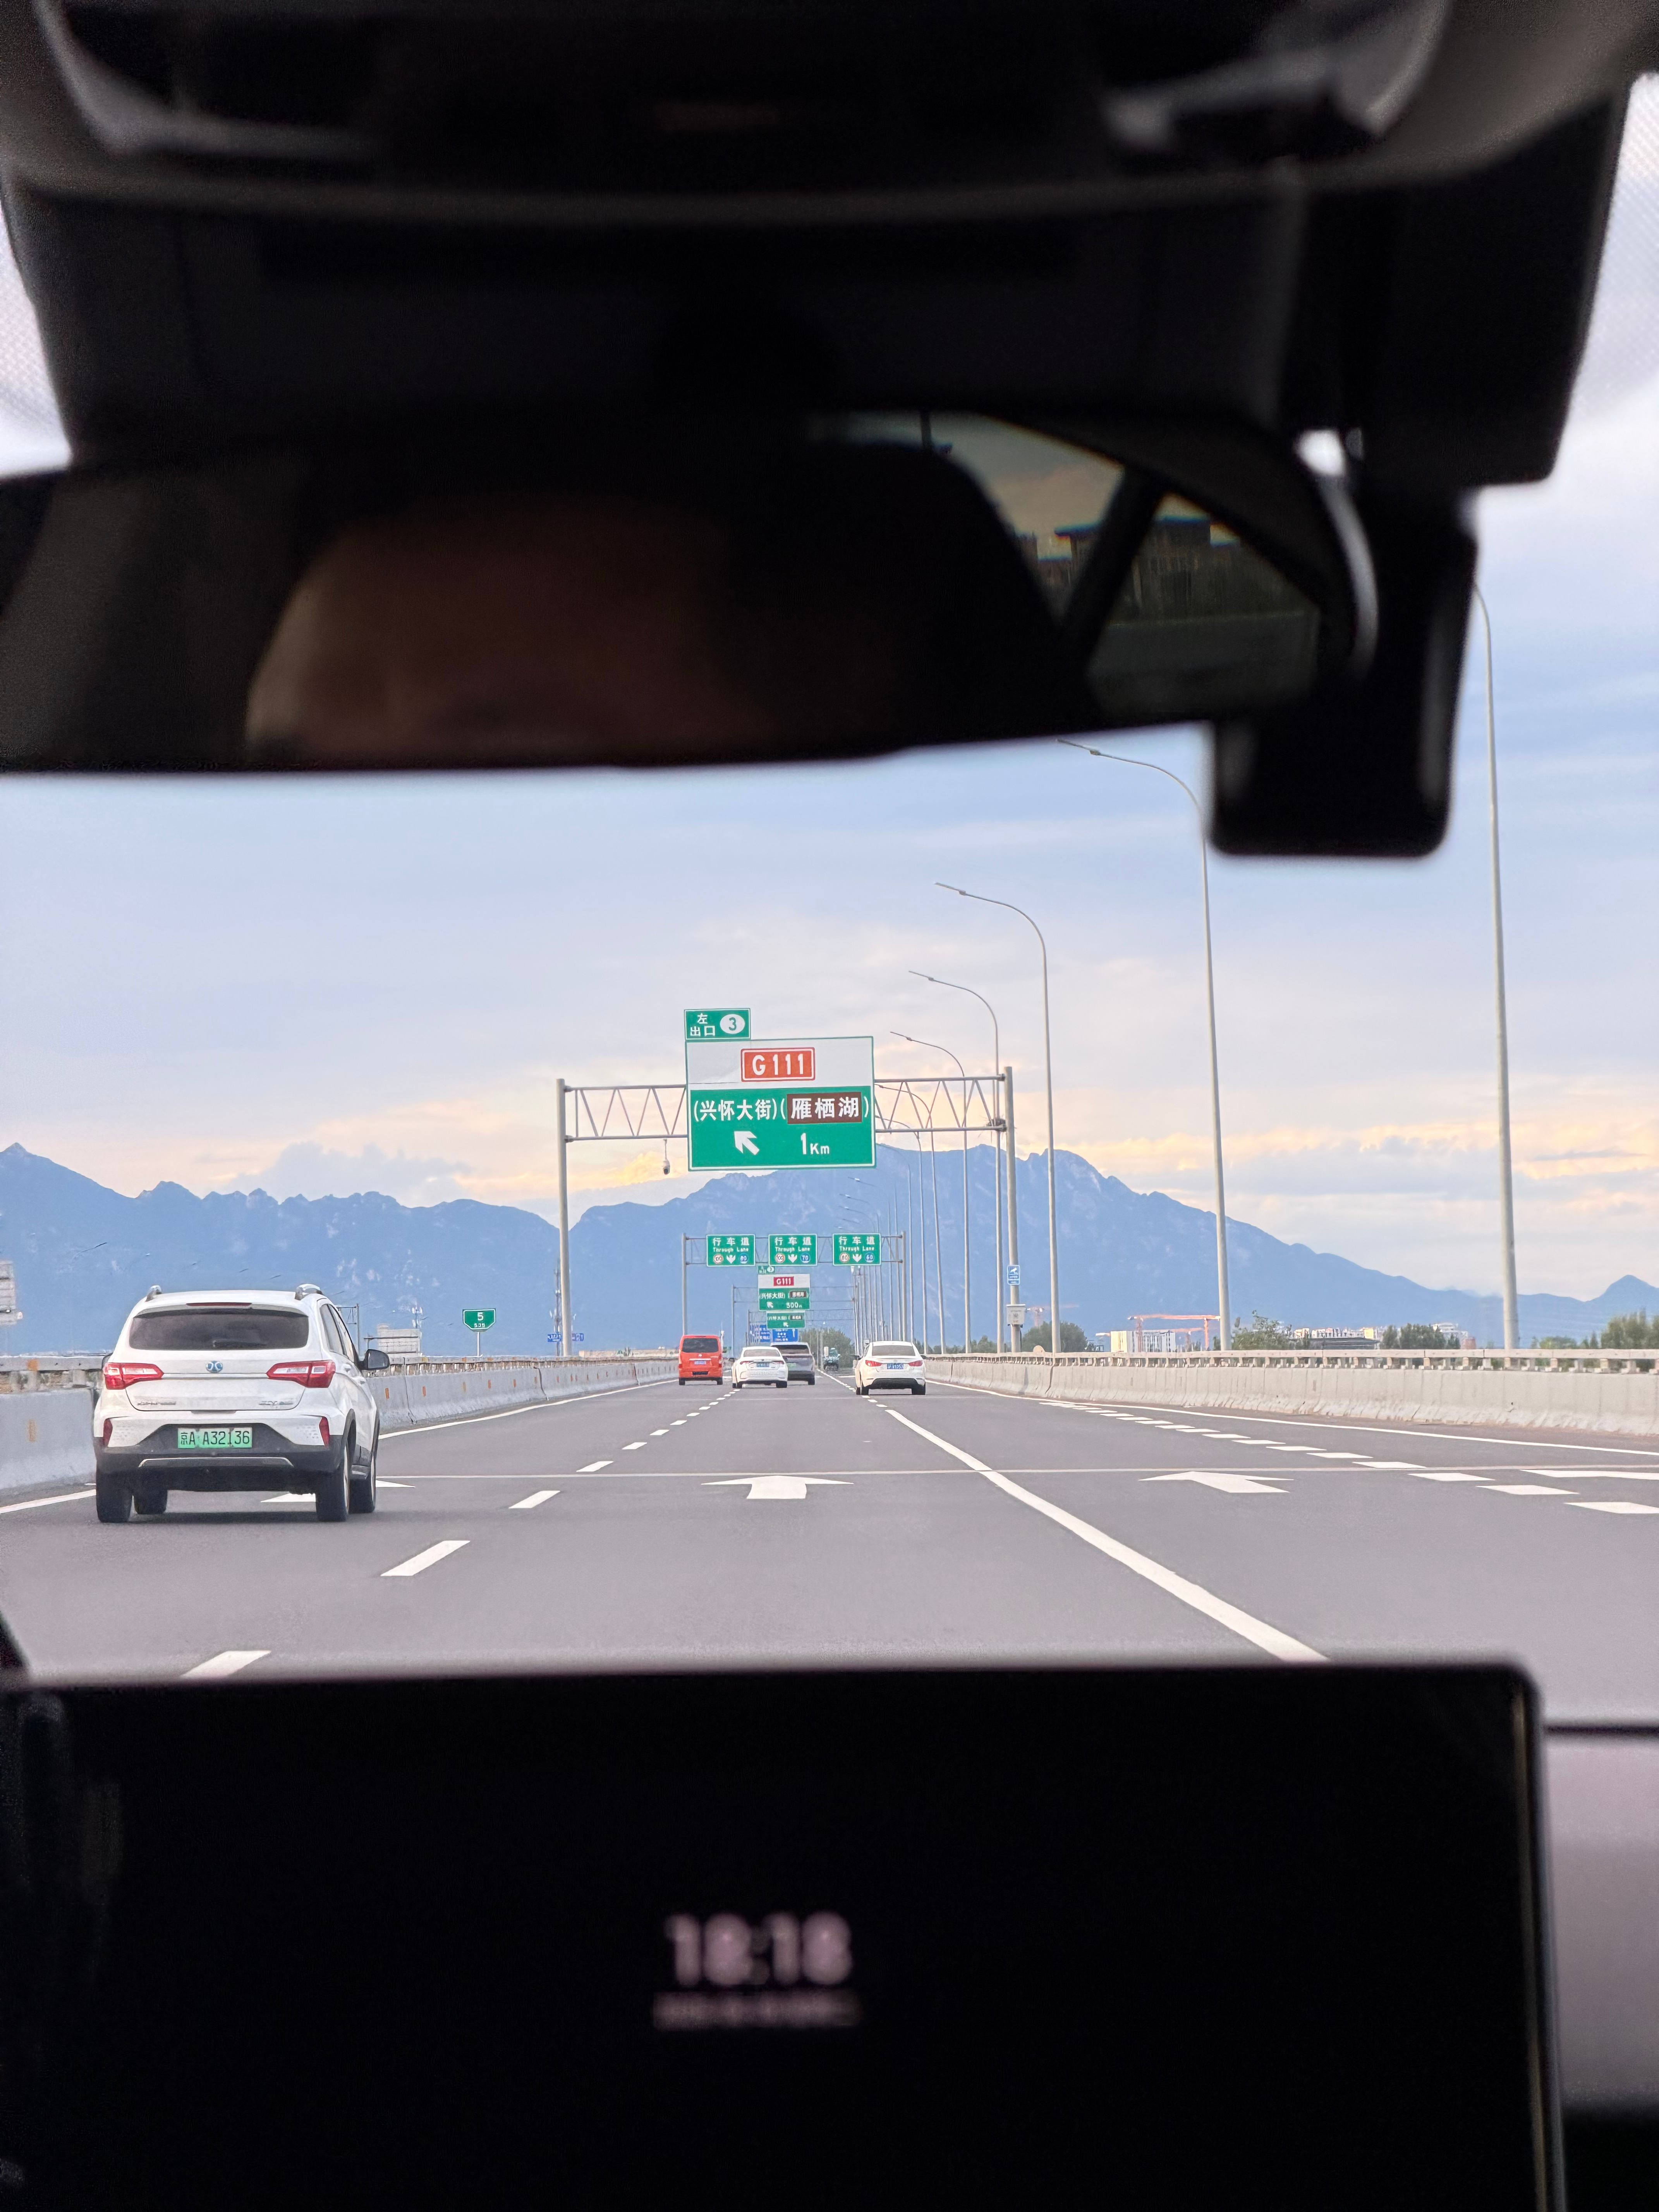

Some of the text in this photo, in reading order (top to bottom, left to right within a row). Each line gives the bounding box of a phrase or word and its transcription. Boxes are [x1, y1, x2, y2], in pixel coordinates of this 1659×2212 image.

[697, 1013, 708, 1024] 左
[728, 1017, 737, 1031] 3
[690, 1026, 715, 1037] 出口
[752, 1053, 804, 1075] G111
[713, 1237, 750, 1246] 行车道
[775, 1237, 812, 1246] 行车道
[839, 1236, 875, 1245] 行车道
[477, 1312, 484, 1321] 5
